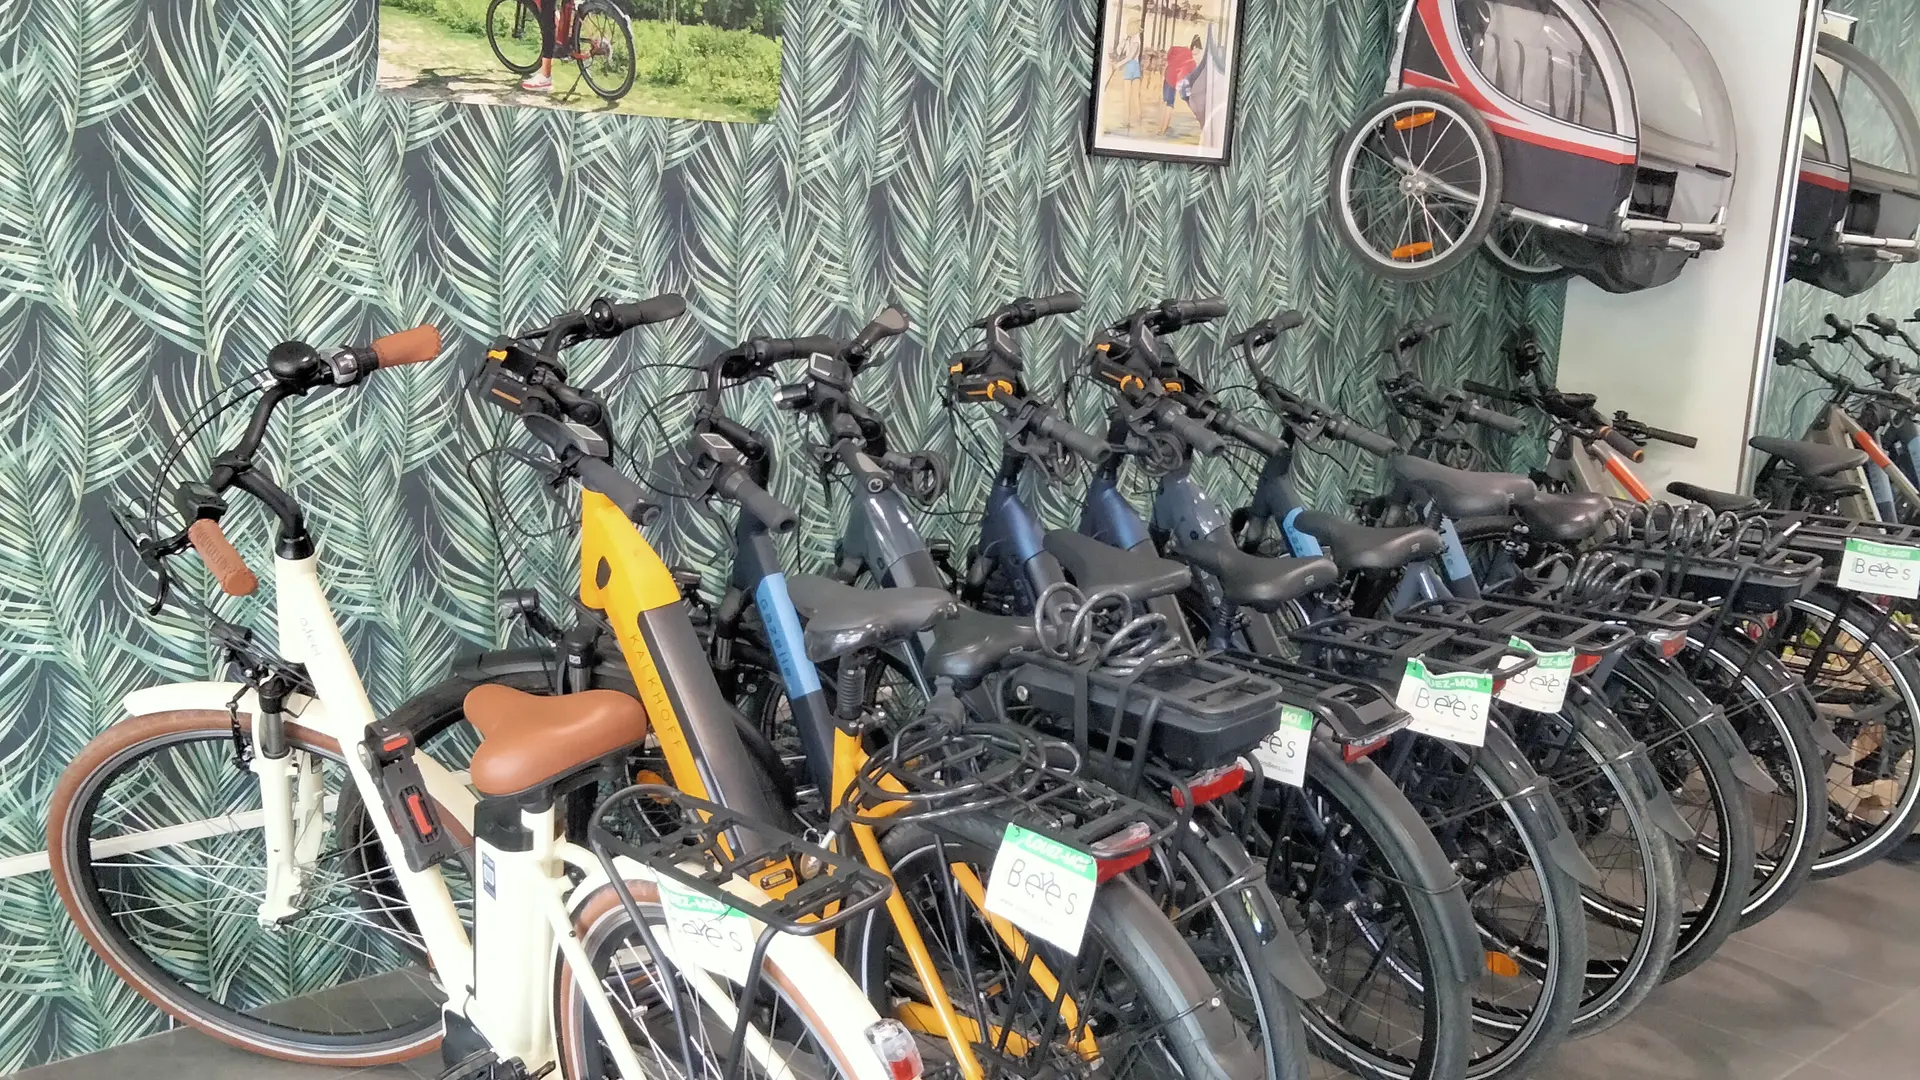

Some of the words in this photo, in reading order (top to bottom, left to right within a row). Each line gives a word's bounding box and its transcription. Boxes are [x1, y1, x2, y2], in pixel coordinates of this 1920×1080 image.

[1854, 557, 1911, 581] Bees
[760, 598, 792, 677] Gazelle
[629, 634, 684, 749] KALKHOFF
[1415, 687, 1479, 721] Bees
[1007, 858, 1078, 915] Bees
